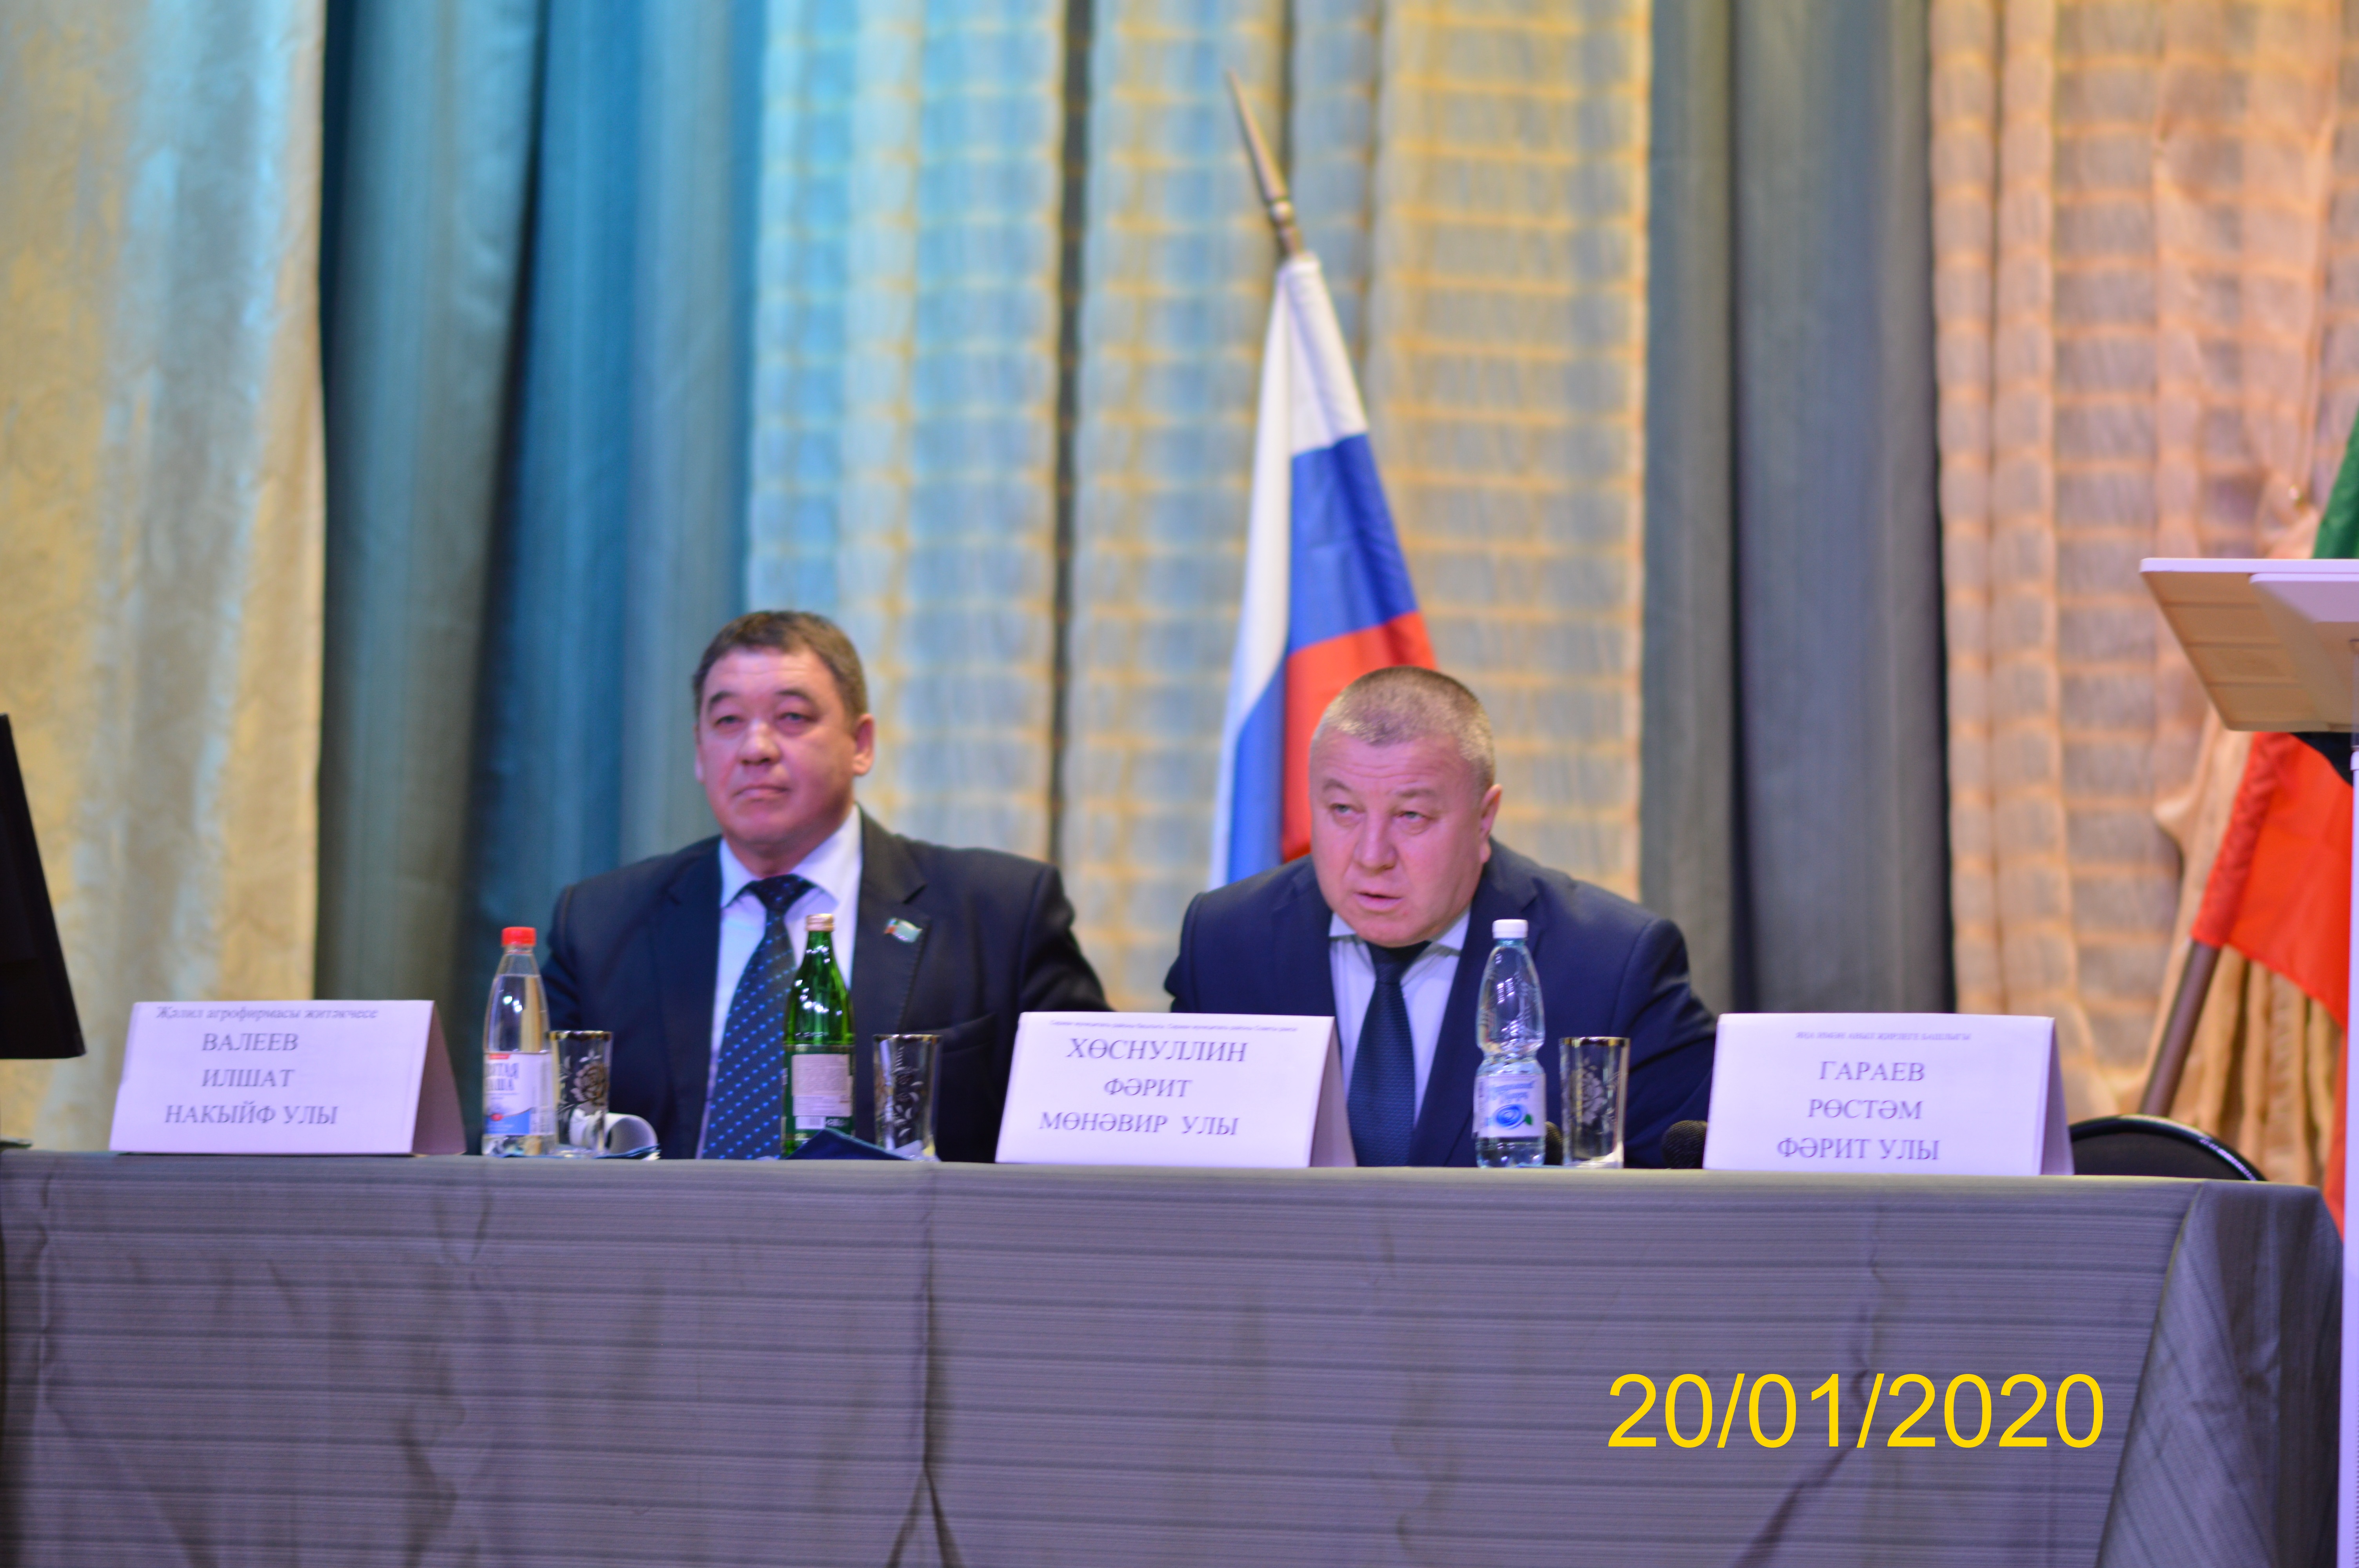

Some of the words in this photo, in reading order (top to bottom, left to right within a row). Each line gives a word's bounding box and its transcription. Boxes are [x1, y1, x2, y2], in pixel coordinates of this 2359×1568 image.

[201, 1033, 299, 1052] ВАЛЕЕВ
[1065, 1037, 1249, 1062] ХӨСНУЛЛИН
[201, 1068, 296, 1088] ИЛШАТ
[1819, 1060, 1926, 1082] ГАРАЕВ
[1103, 1077, 1193, 1098] ФӘРИТ
[164, 1100, 276, 1125] НАКЫЙФ
[283, 1105, 339, 1125] УЛЫ
[1807, 1098, 1923, 1120] РӨСТӘМ
[1039, 1111, 1169, 1134] МӨНӘВИР
[1181, 1115, 1239, 1136] УЛЫ
[1776, 1137, 1872, 1160] ФӘРИТ
[1879, 1138, 1940, 1161] УЛЫ
